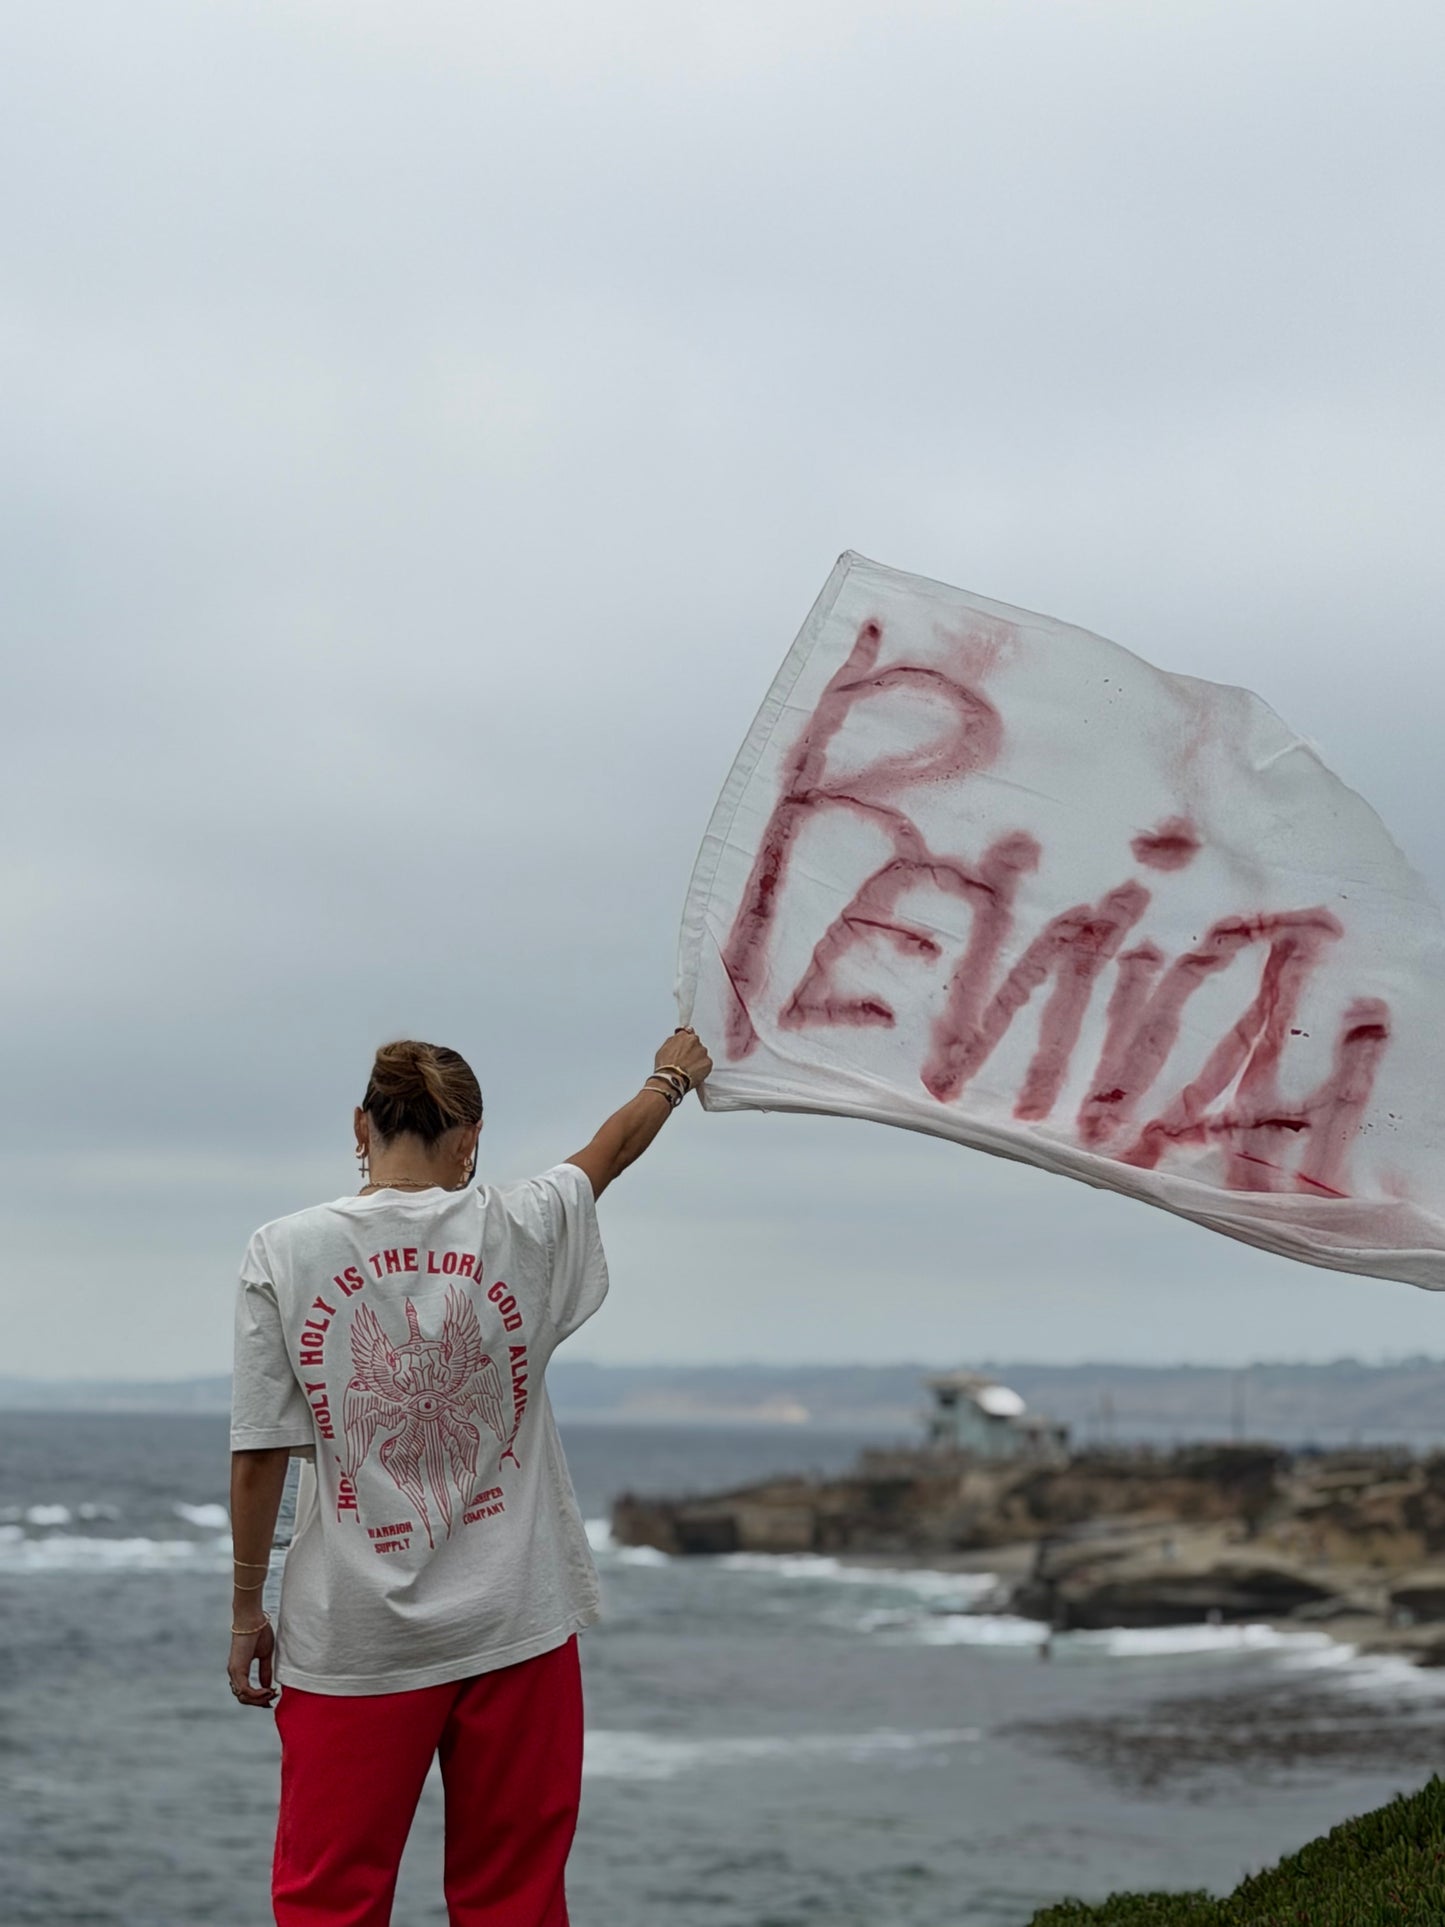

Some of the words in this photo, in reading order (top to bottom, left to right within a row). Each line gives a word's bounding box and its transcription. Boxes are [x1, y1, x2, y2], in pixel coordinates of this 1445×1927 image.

[368, 1247, 419, 1279] THE
[333, 1266, 365, 1298] IS
[487, 1280, 523, 1333] GOD
[299, 1296, 337, 1366] HOLY
[304, 1381, 336, 1440] HOLY
[463, 1501, 506, 1526] COMPANY
[367, 1521, 414, 1540] WARRIOR
[374, 1537, 411, 1555] SUPPLY
